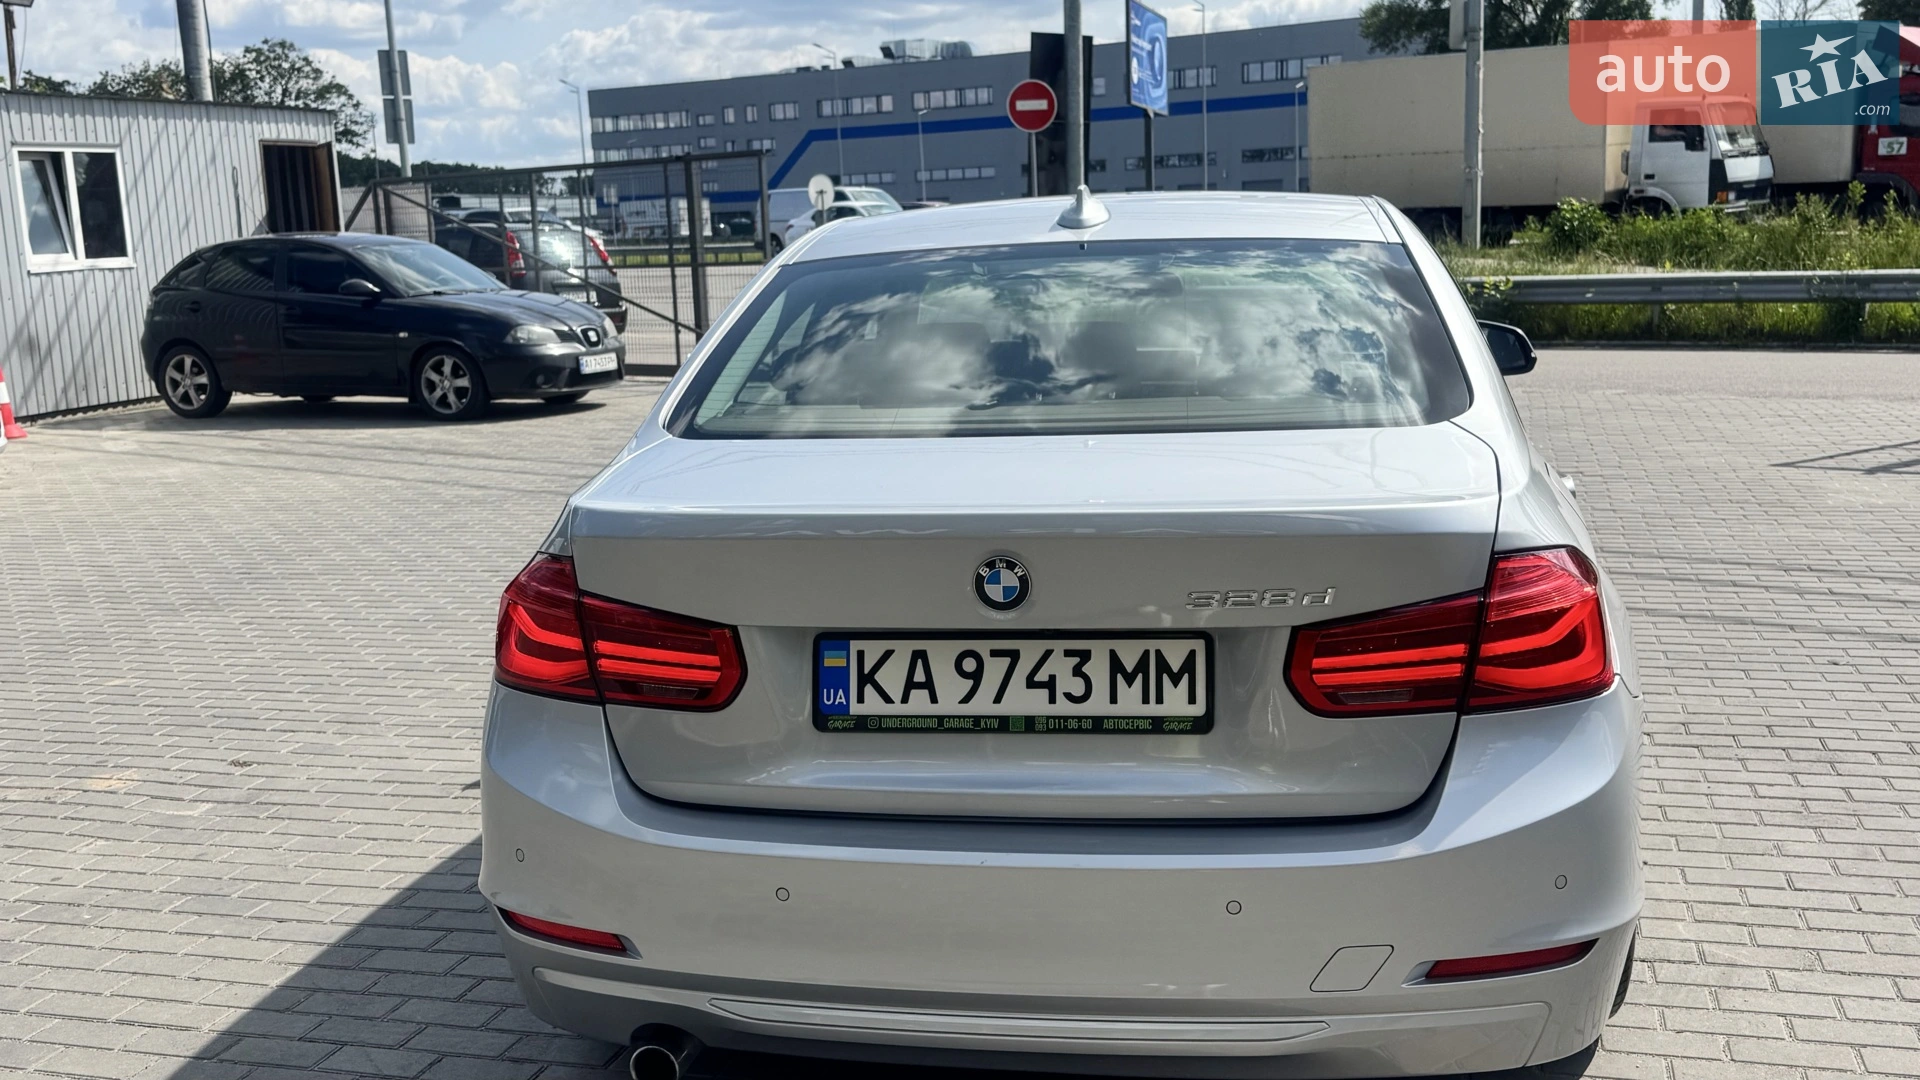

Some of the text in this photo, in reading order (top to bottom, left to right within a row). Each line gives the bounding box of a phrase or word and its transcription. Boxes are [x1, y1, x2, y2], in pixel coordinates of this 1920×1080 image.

[979, 558, 1026, 577] BMW
[1185, 586, 1337, 609] 328d
[856, 649, 1197, 704] KA 9743 MM
[823, 688, 847, 705] UA
[881, 717, 999, 730] UNDERGROUND_GARAGE_KYIV
[1048, 718, 1093, 729] 011-06-60
[1102, 718, 1153, 729] АВТОСЕРВІС
